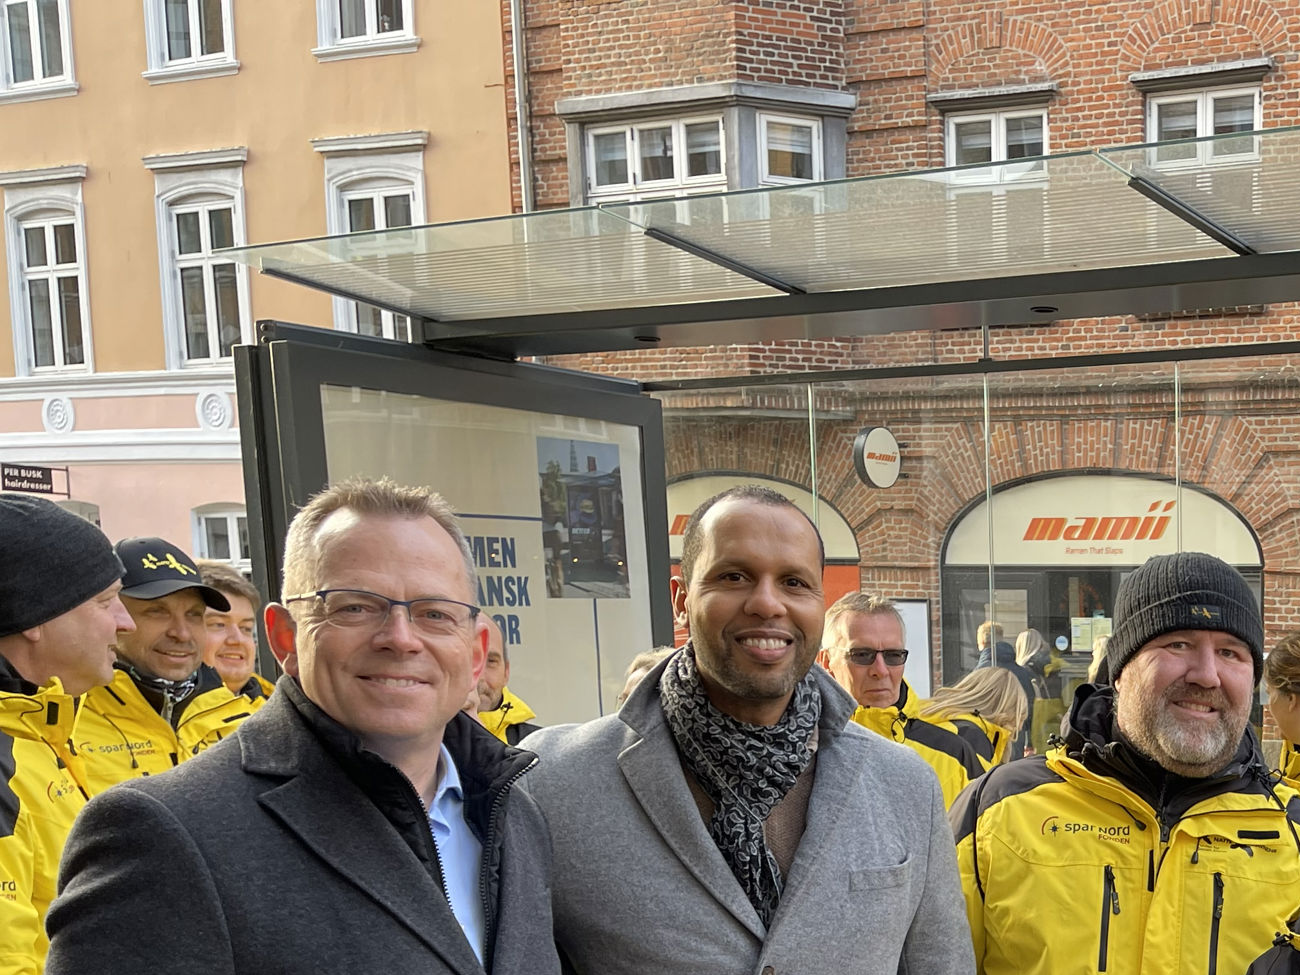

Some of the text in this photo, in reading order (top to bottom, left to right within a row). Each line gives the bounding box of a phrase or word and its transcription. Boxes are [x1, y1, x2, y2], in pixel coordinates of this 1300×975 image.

[4, 468, 43, 479] PER BUSK
[4, 479, 52, 491] hairdresser
[1023, 500, 1176, 541] mamii
[464, 536, 517, 568] MEN
[1065, 547, 1088, 555] Ramen
[1089, 547, 1104, 555] That
[478, 575, 531, 607] ANSK
[491, 614, 521, 645] OR
[1064, 823, 1130, 836] spar Nord
